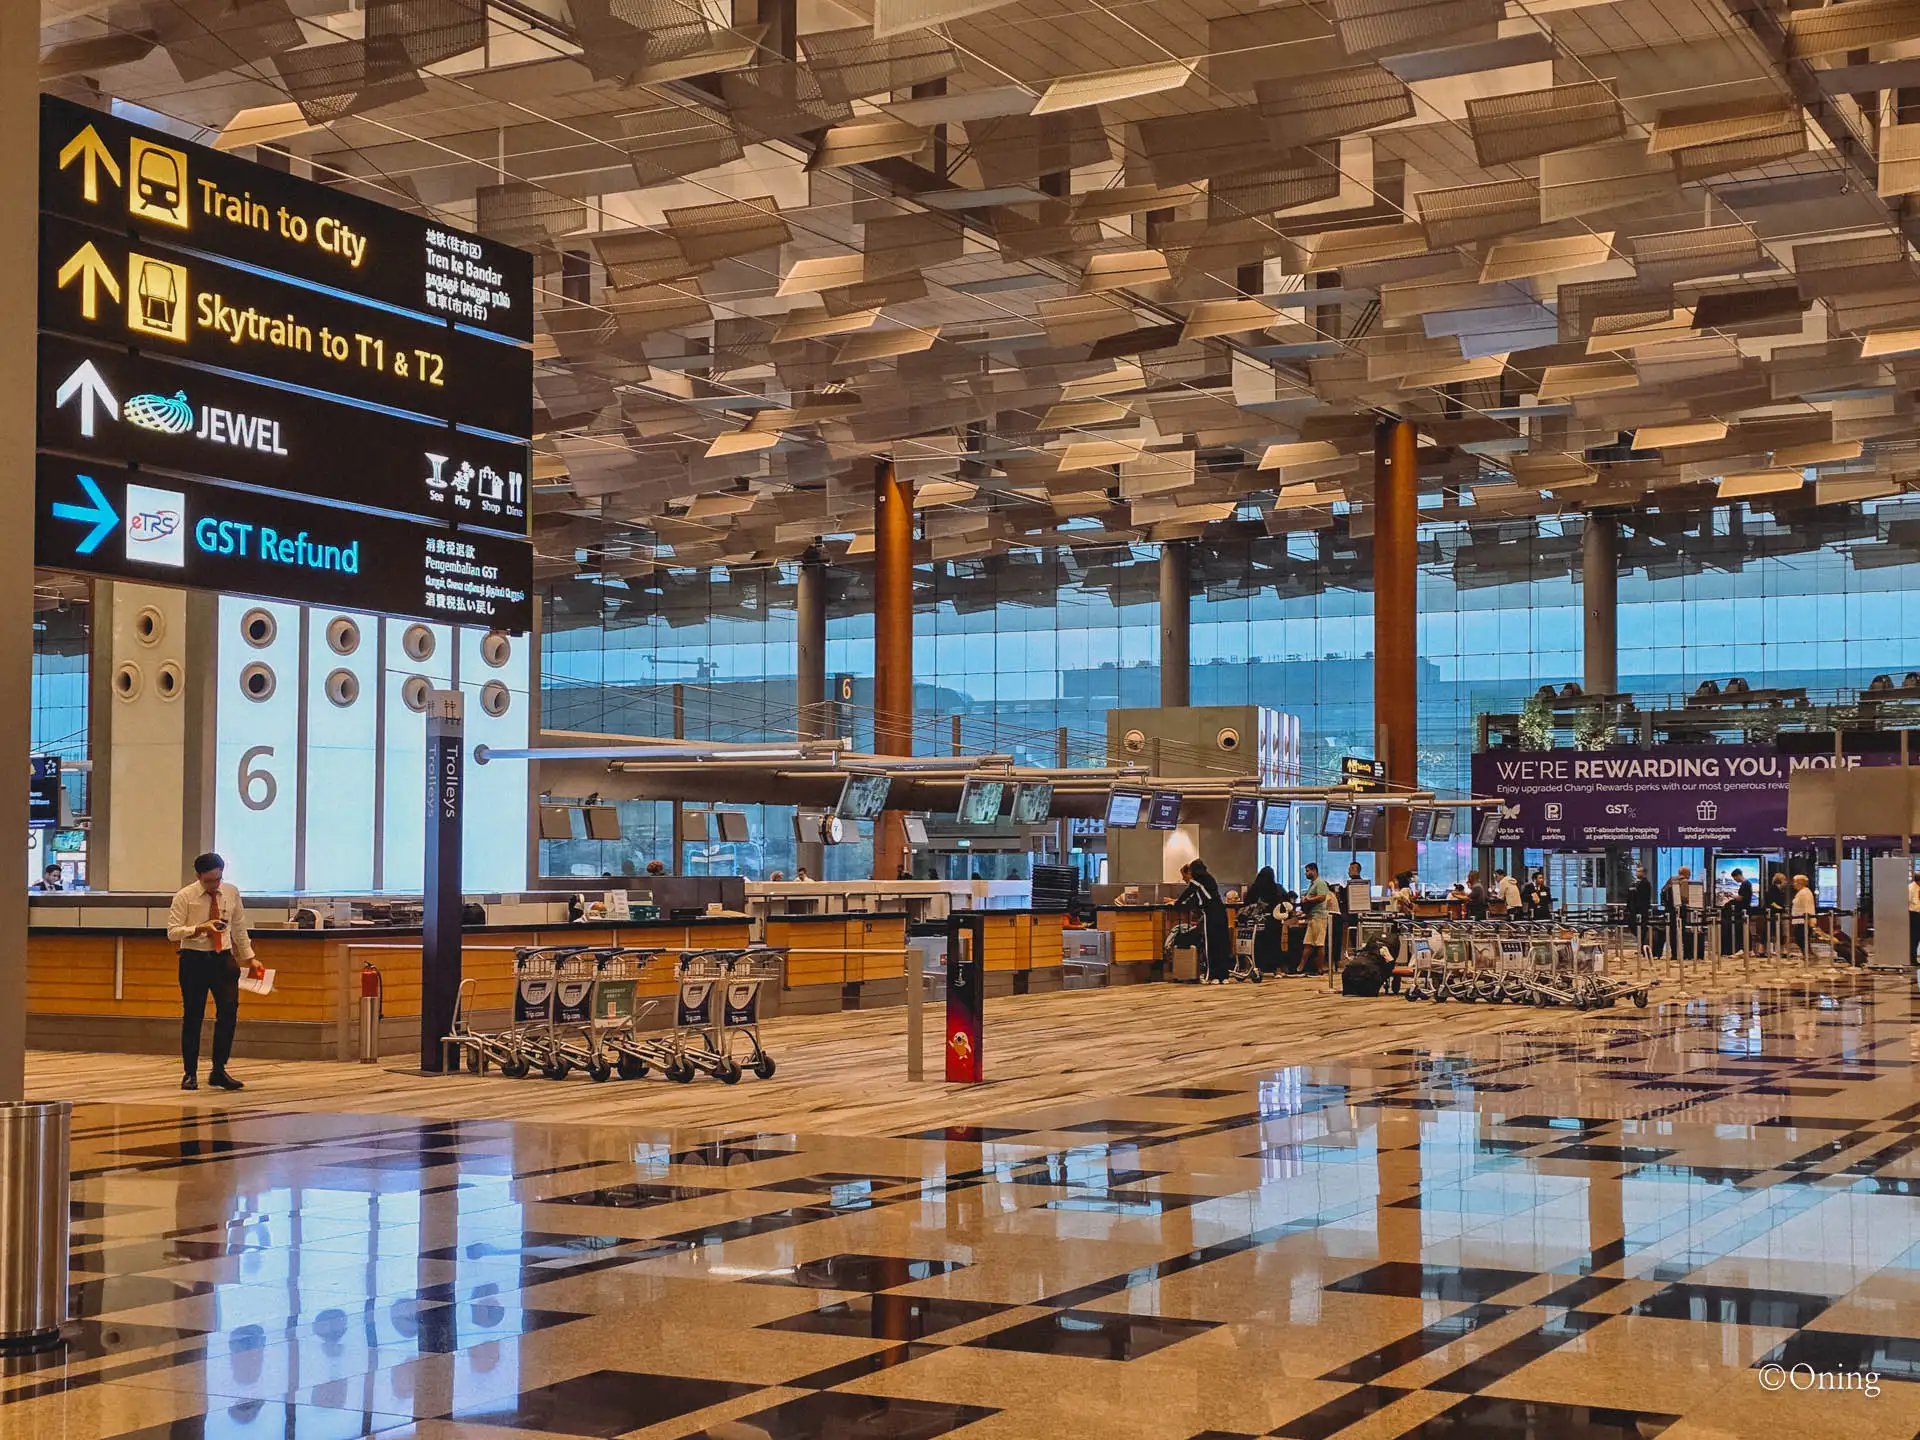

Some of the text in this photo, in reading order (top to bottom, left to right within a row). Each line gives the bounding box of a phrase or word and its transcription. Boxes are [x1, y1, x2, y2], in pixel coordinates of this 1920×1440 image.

[197, 178, 367, 268] Train to City
[425, 247, 503, 286] Tren ke Bandar
[196, 292, 445, 386] Skytrain to T1 & T2
[196, 405, 288, 456] JEWEL
[132, 512, 174, 534] eTRS
[429, 490, 523, 517] See Play Shop Dine
[195, 517, 358, 574] GST Refund
[425, 556, 499, 580] Pengembalian GST
[842, 679, 851, 699] 6
[238, 745, 277, 811] 6
[427, 743, 437, 817] Trolleys
[443, 745, 458, 818] Trolleys
[1496, 760, 1569, 780] WE'RE
[1574, 758, 1720, 779] REWARDING
[1724, 757, 1782, 779] YOU,
[1497, 784, 1520, 794] Enjoy
[1521, 783, 1563, 794] upgraded
[1564, 783, 1594, 794] Changi
[1596, 782, 1634, 792] Rewards
[1635, 782, 1660, 792] perks
[1661, 782, 1681, 791] with
[1699, 782, 1721, 791] most
[1723, 783, 1766, 792] generous
[1678, 826, 1705, 834] Birthday
